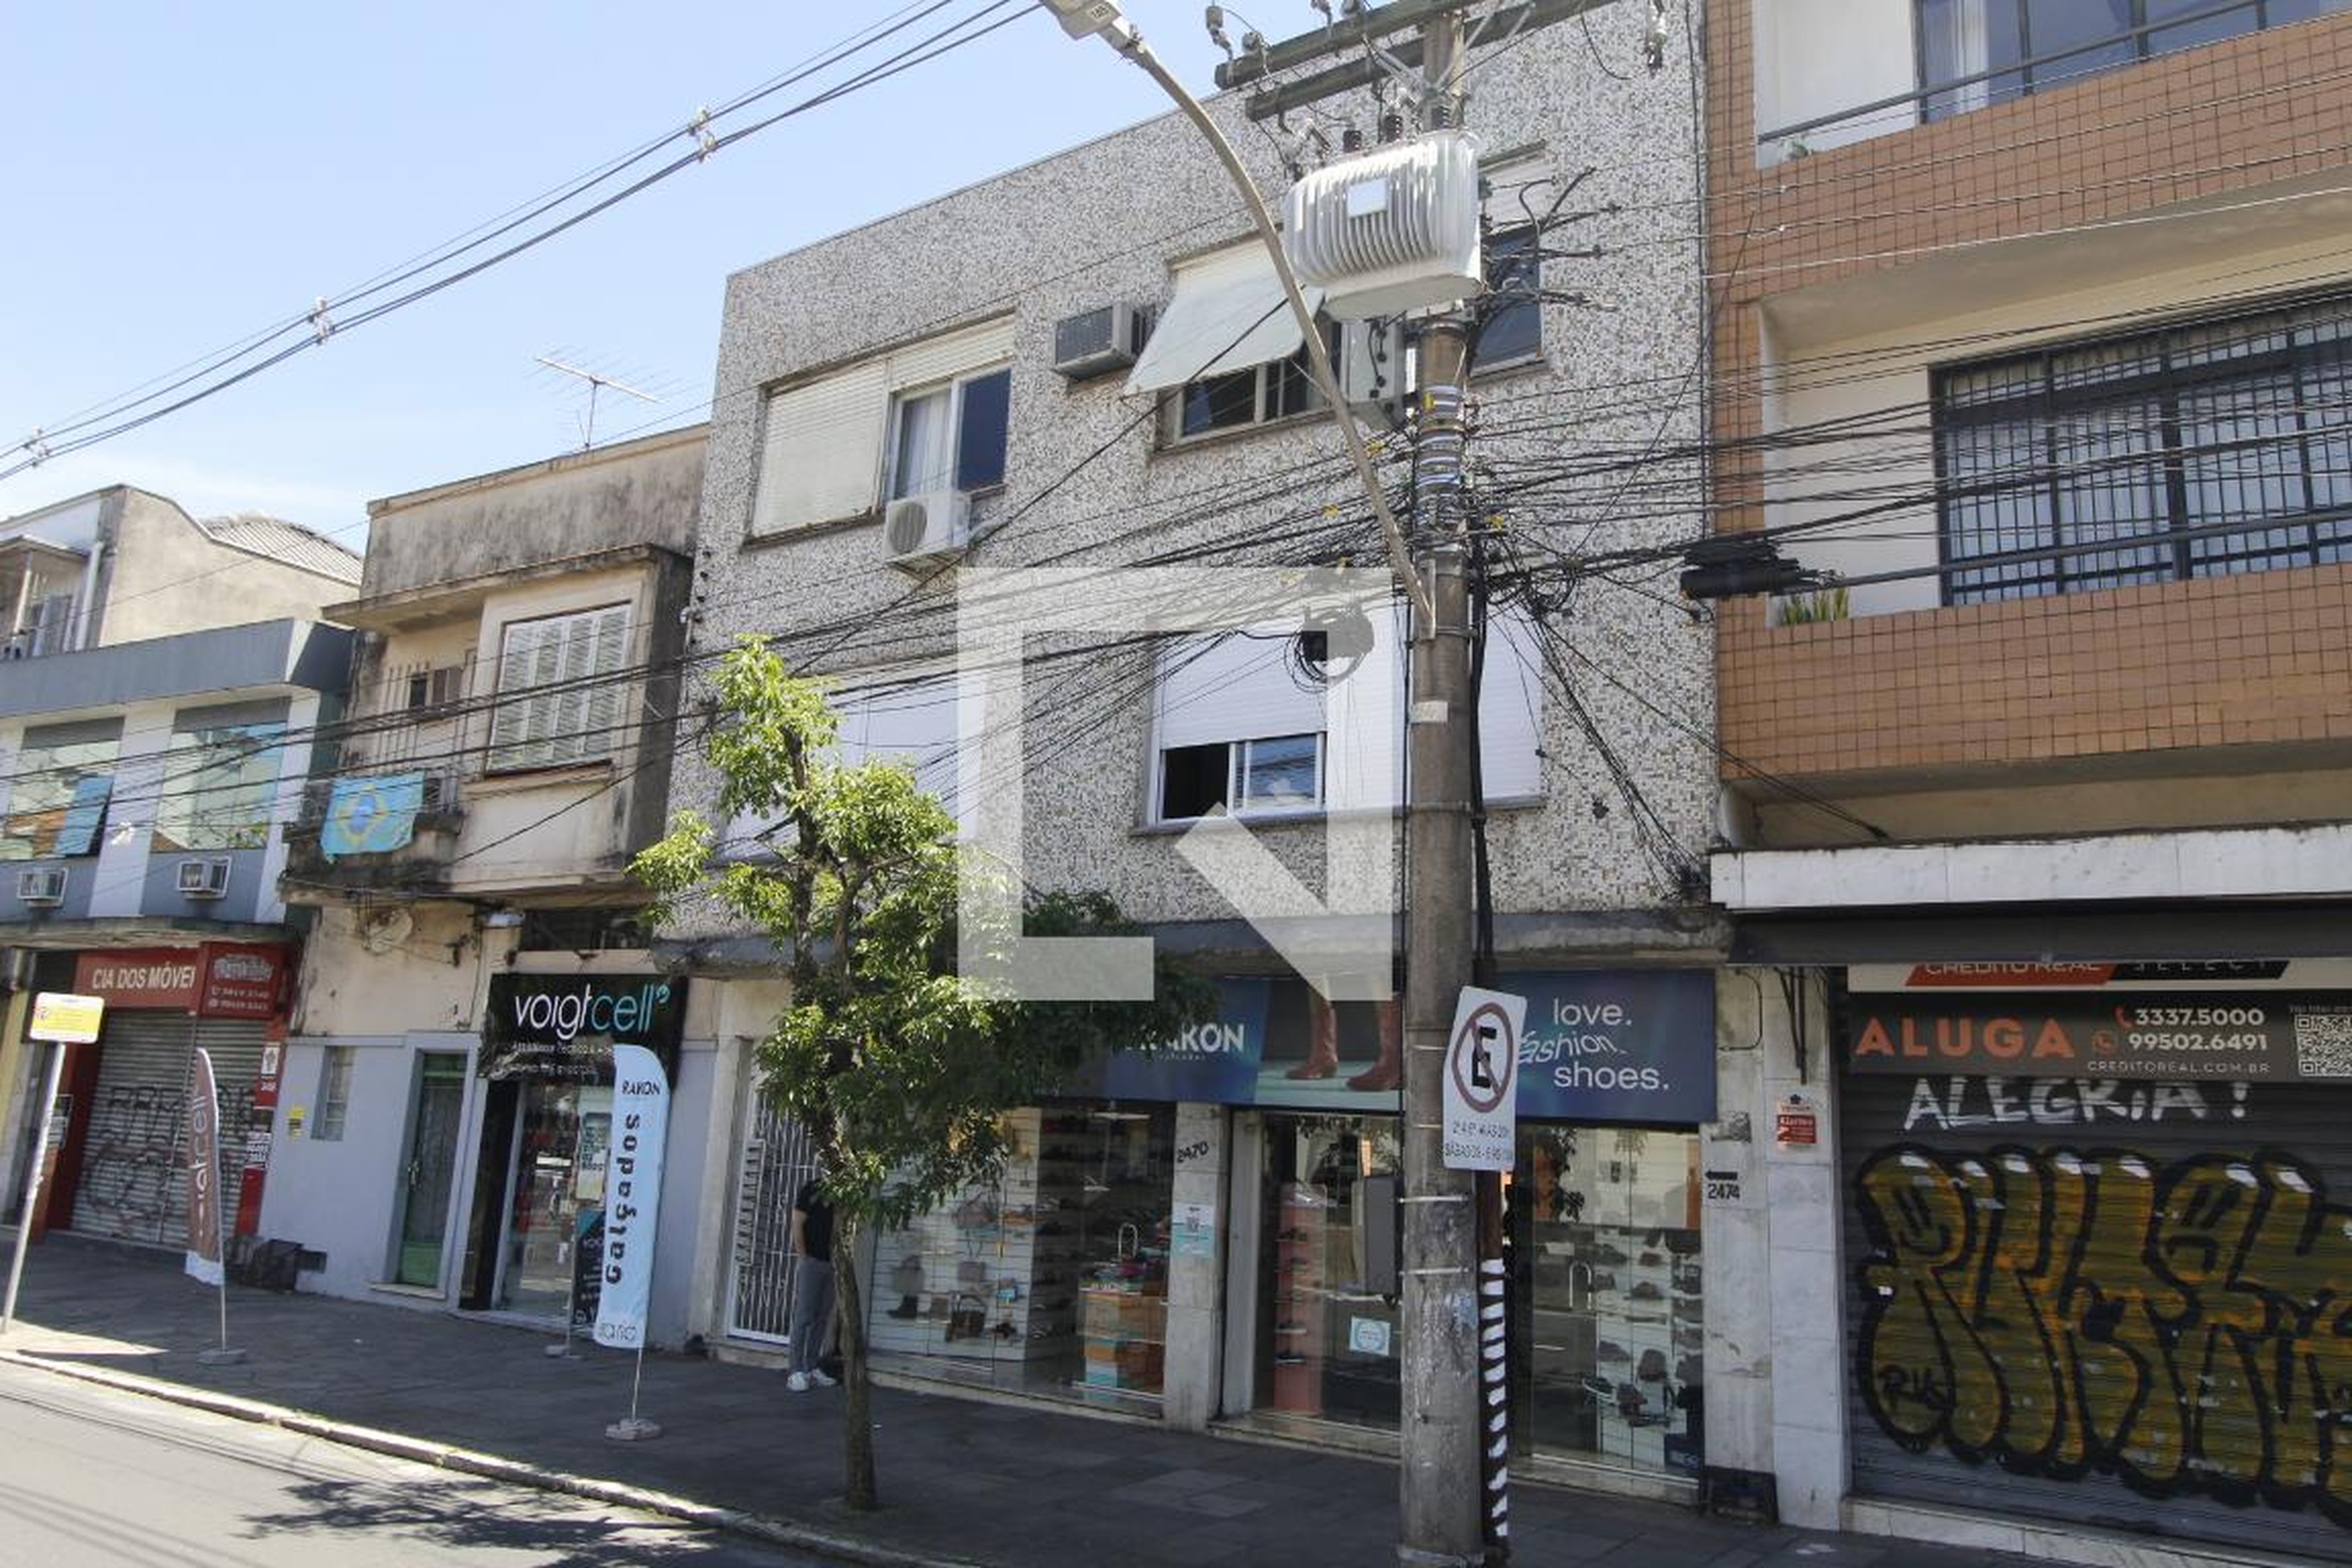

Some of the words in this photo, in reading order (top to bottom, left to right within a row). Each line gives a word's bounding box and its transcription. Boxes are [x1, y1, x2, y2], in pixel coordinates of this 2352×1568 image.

[92, 968, 114, 989] CIA
[117, 967, 146, 989] DOS
[1553, 998, 1633, 1026] love.
[2136, 1009, 2265, 1026] 3337.5000
[1855, 1017, 2075, 1058] ALUGA
[2128, 1033, 2267, 1051] 99502.6491
[1472, 1027, 1497, 1088] E
[2087, 1060, 2271, 1073] CREDITOREAL.COM.BR
[1553, 1061, 1670, 1090] shoes.
[1177, 1141, 1209, 1163] 2470
[1708, 1183, 1741, 1200] 2474
